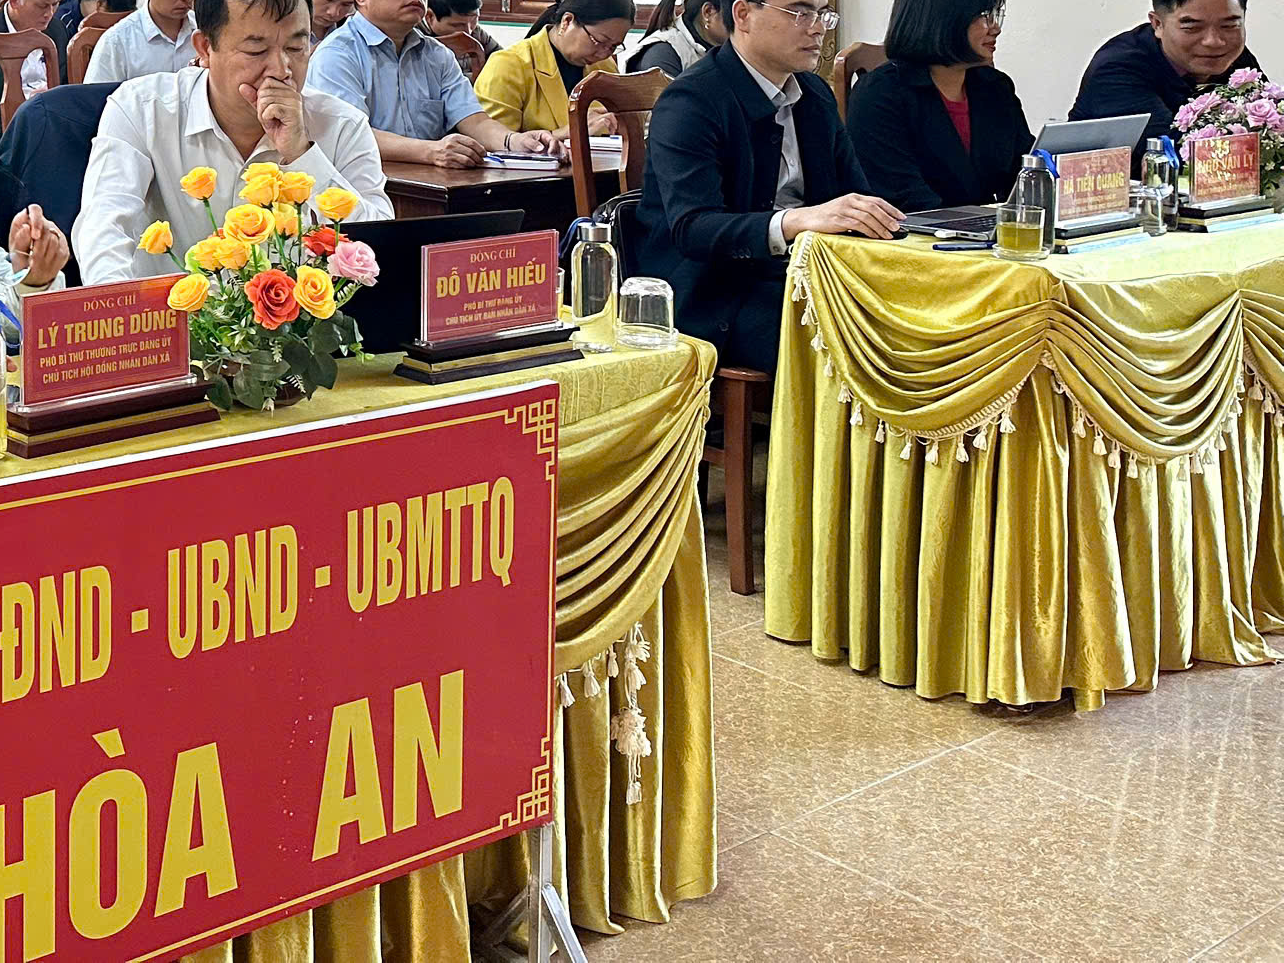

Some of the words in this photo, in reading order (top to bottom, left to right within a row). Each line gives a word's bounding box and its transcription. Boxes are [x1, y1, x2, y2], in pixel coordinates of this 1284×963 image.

[38, 321, 59, 349] LÝ
[64, 316, 124, 345] TRUNG
[130, 308, 177, 334] DŨNG
[436, 267, 460, 298] ĐỖ
[466, 267, 501, 294] VĂN
[506, 257, 546, 289] HIẾU
[167, 523, 298, 659] UBND
[345, 475, 516, 613] UBMTTQ
[310, 669, 465, 863] AN
